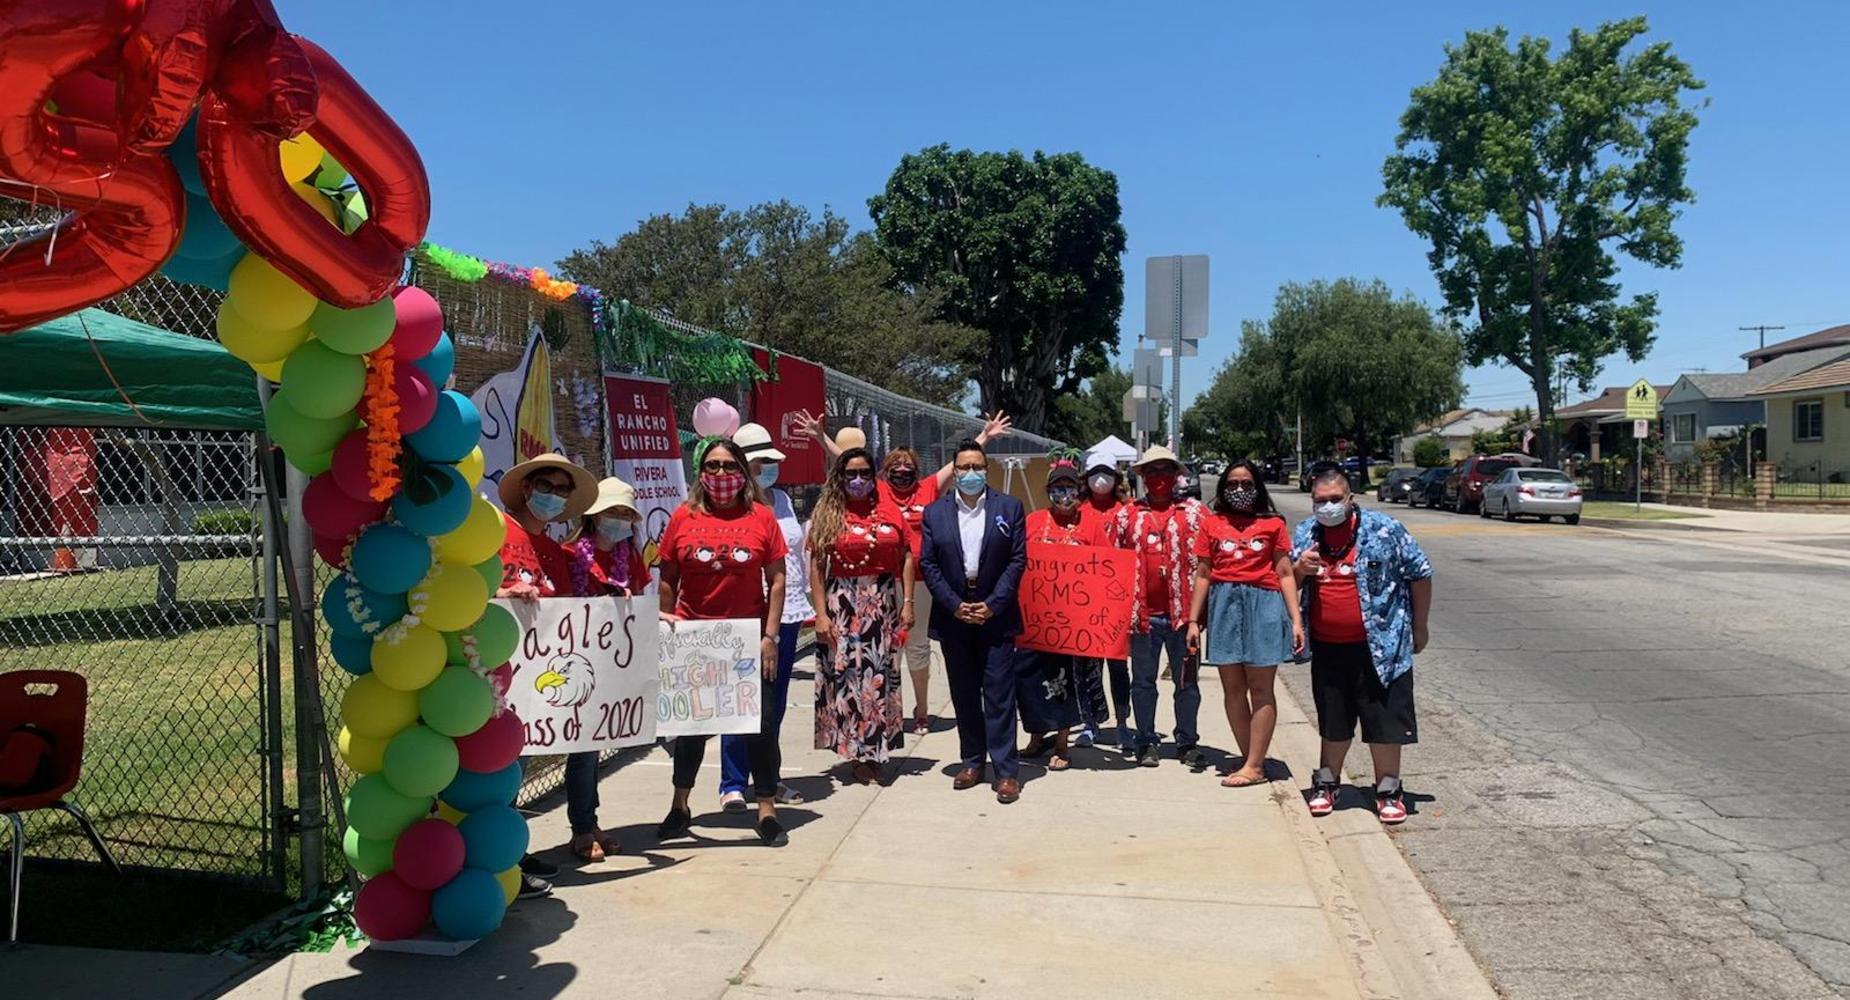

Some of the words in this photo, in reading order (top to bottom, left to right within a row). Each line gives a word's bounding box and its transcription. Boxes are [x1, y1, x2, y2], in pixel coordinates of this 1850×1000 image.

[633, 394, 648, 410] EL
[616, 414, 667, 431] RANCHO
[620, 434, 670, 451] UNIFIED
[634, 466, 667, 482] RIVERA
[634, 487, 653, 500] DDLE
[655, 486, 681, 499] SCHOOL
[1026, 553, 1116, 582] ongrats
[1031, 577, 1091, 607] RMS
[1023, 603, 1071, 625] lass
[1089, 606, 1110, 627] of
[523, 603, 636, 669] agles
[657, 622, 745, 662] fficially
[1021, 624, 1093, 653] 2020
[655, 681, 759, 722] OOLER
[563, 703, 582, 742] of
[592, 696, 644, 742] 2020
